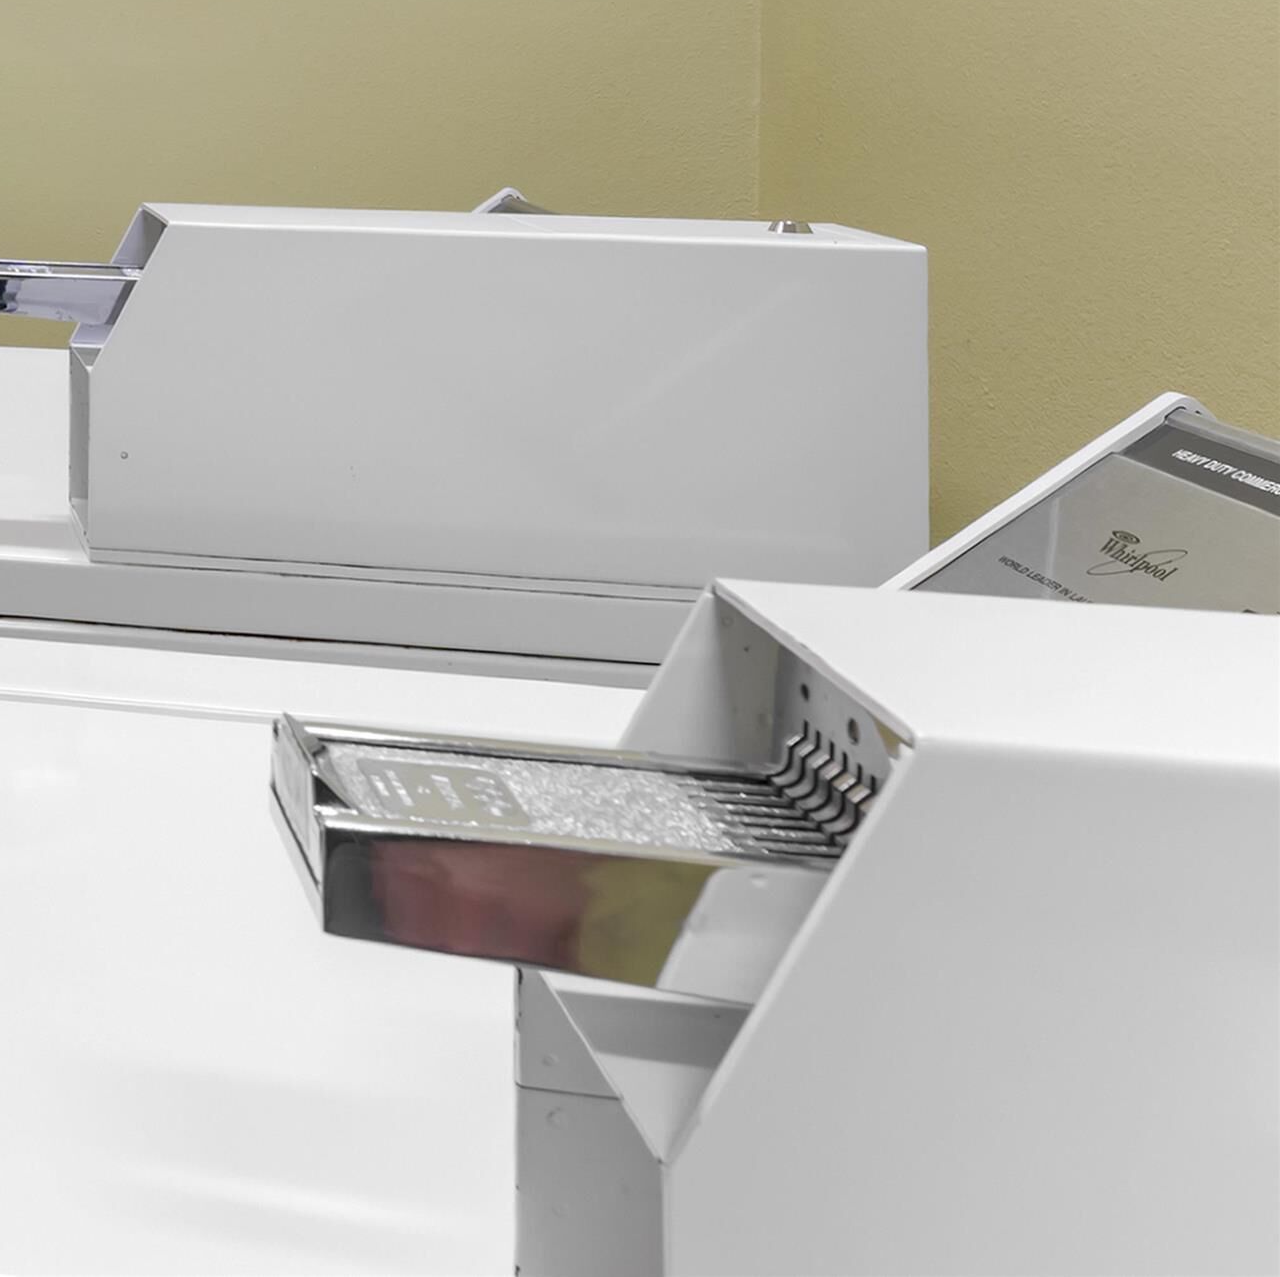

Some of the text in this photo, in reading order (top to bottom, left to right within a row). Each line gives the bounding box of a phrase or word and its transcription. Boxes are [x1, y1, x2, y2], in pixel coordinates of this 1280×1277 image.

[1171, 449, 1211, 466] HEAVY
[1203, 460, 1238, 475] DUTY
[998, 555, 1030, 575] WORLD
[1026, 570, 1062, 592] LEADER
[1059, 587, 1073, 597] IN
[1086, 537, 1188, 582] Whirlpool
